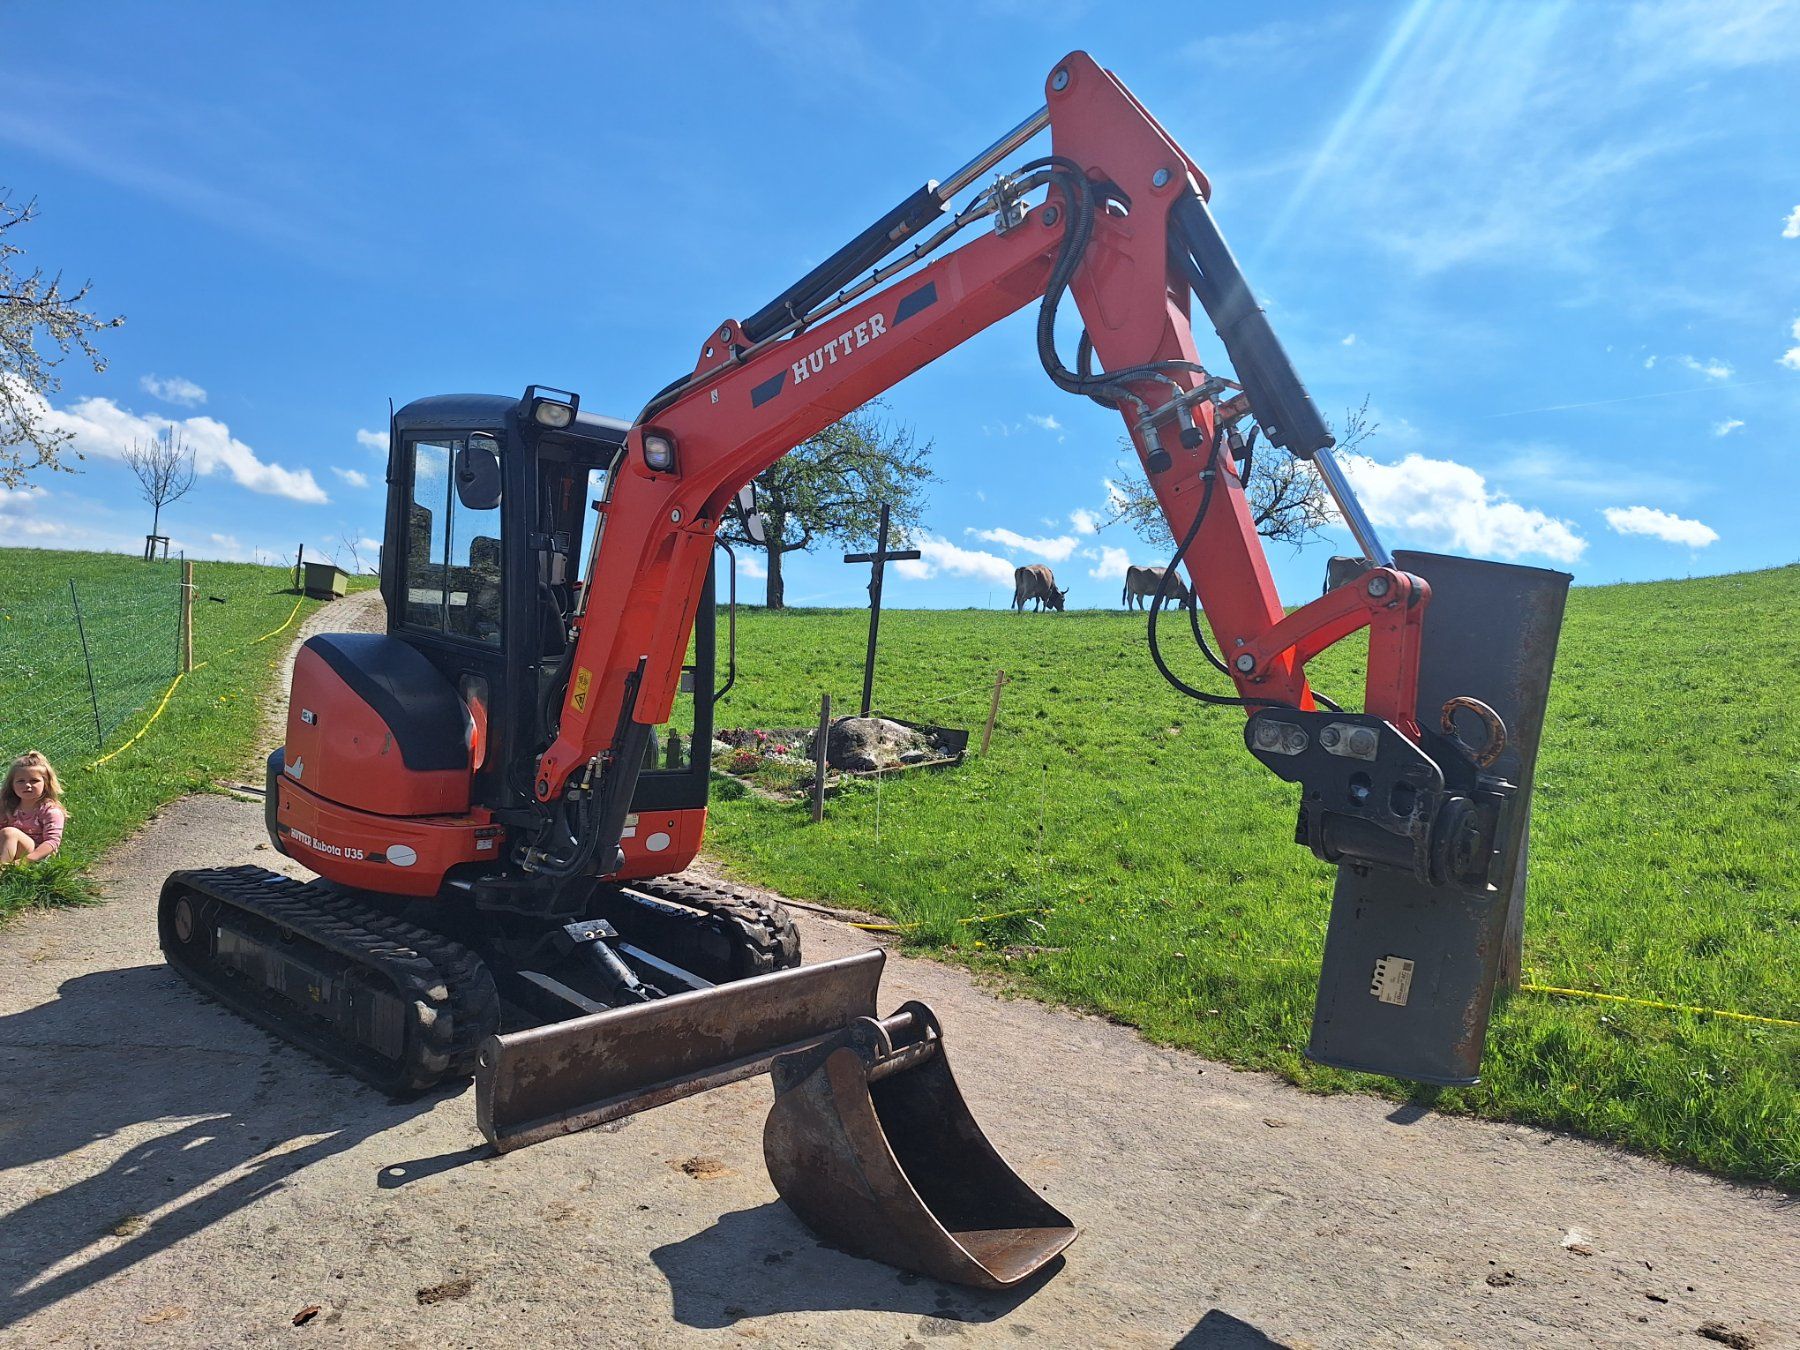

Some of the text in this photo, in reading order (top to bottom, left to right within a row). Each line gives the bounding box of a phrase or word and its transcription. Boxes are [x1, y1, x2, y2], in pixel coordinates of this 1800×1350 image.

[791, 312, 887, 385] HUTTER
[312, 838, 341, 856] Kubota
[344, 847, 364, 860] U35
